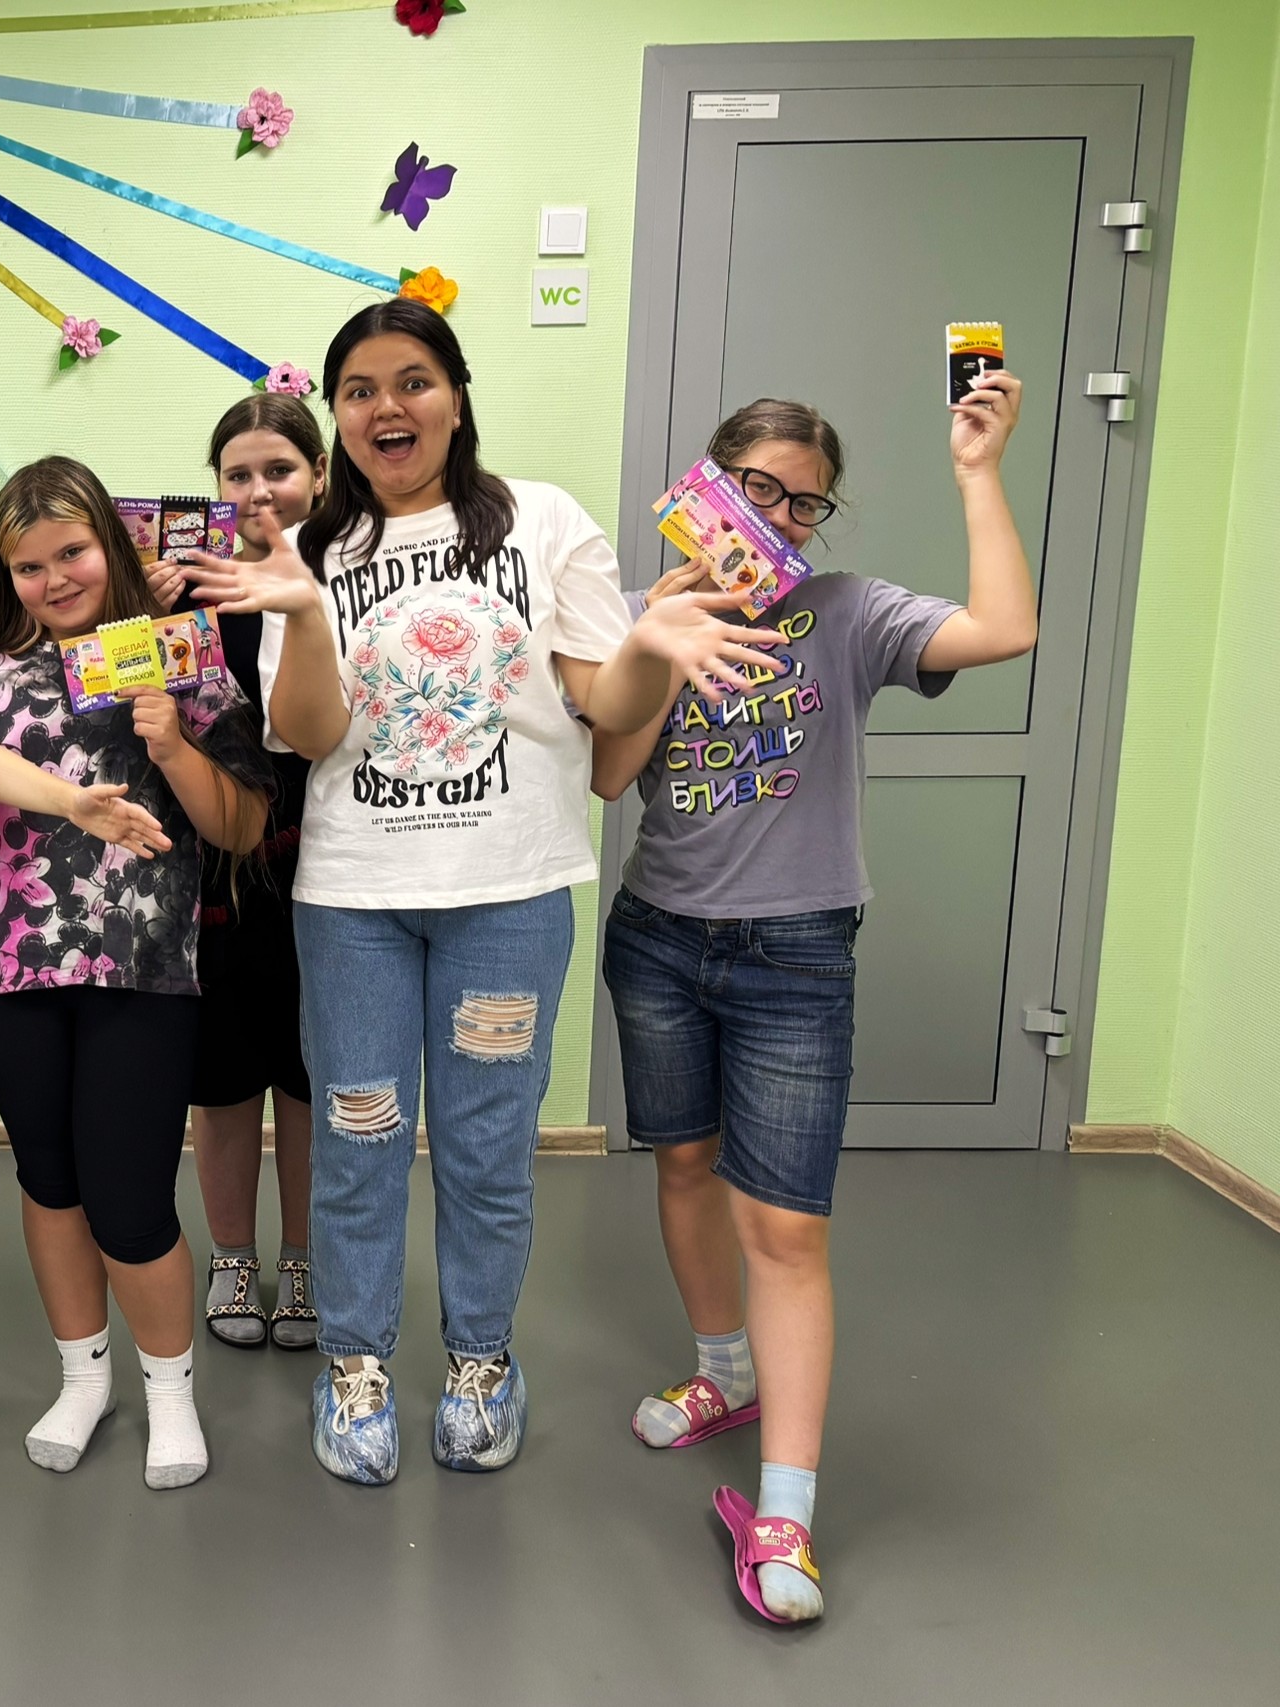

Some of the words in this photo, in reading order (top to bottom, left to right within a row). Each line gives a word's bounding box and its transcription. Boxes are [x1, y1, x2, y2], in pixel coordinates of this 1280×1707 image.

[540, 286, 581, 306] WC
[732, 493, 766, 529] РОЖДЕНИЯ
[762, 526, 784, 550] МЕЧТЫ
[382, 543, 418, 555] CLASSIC
[420, 538, 439, 549] AND
[330, 557, 404, 658] FIELD
[411, 544, 532, 632] FLOWER
[111, 639, 149, 657] СДЕЛАЙ
[118, 670, 156, 686] СТРАХОВ
[772, 679, 823, 720] ТЫ
[666, 725, 804, 770] СТОИШЬ
[353, 747, 434, 808] BEST
[437, 727, 510, 806] GIFT
[669, 767, 801, 815] БЛИЗКО
[384, 825, 403, 833] WILD
[404, 823, 436, 832] FLOWERS
[445, 821, 460, 829] OUR
[461, 820, 479, 828] HAIR
[395, 814, 417, 824] DANCE
[426, 812, 441, 820] THE
[442, 812, 459, 820] SUN,
[459, 810, 492, 819] WEARING
